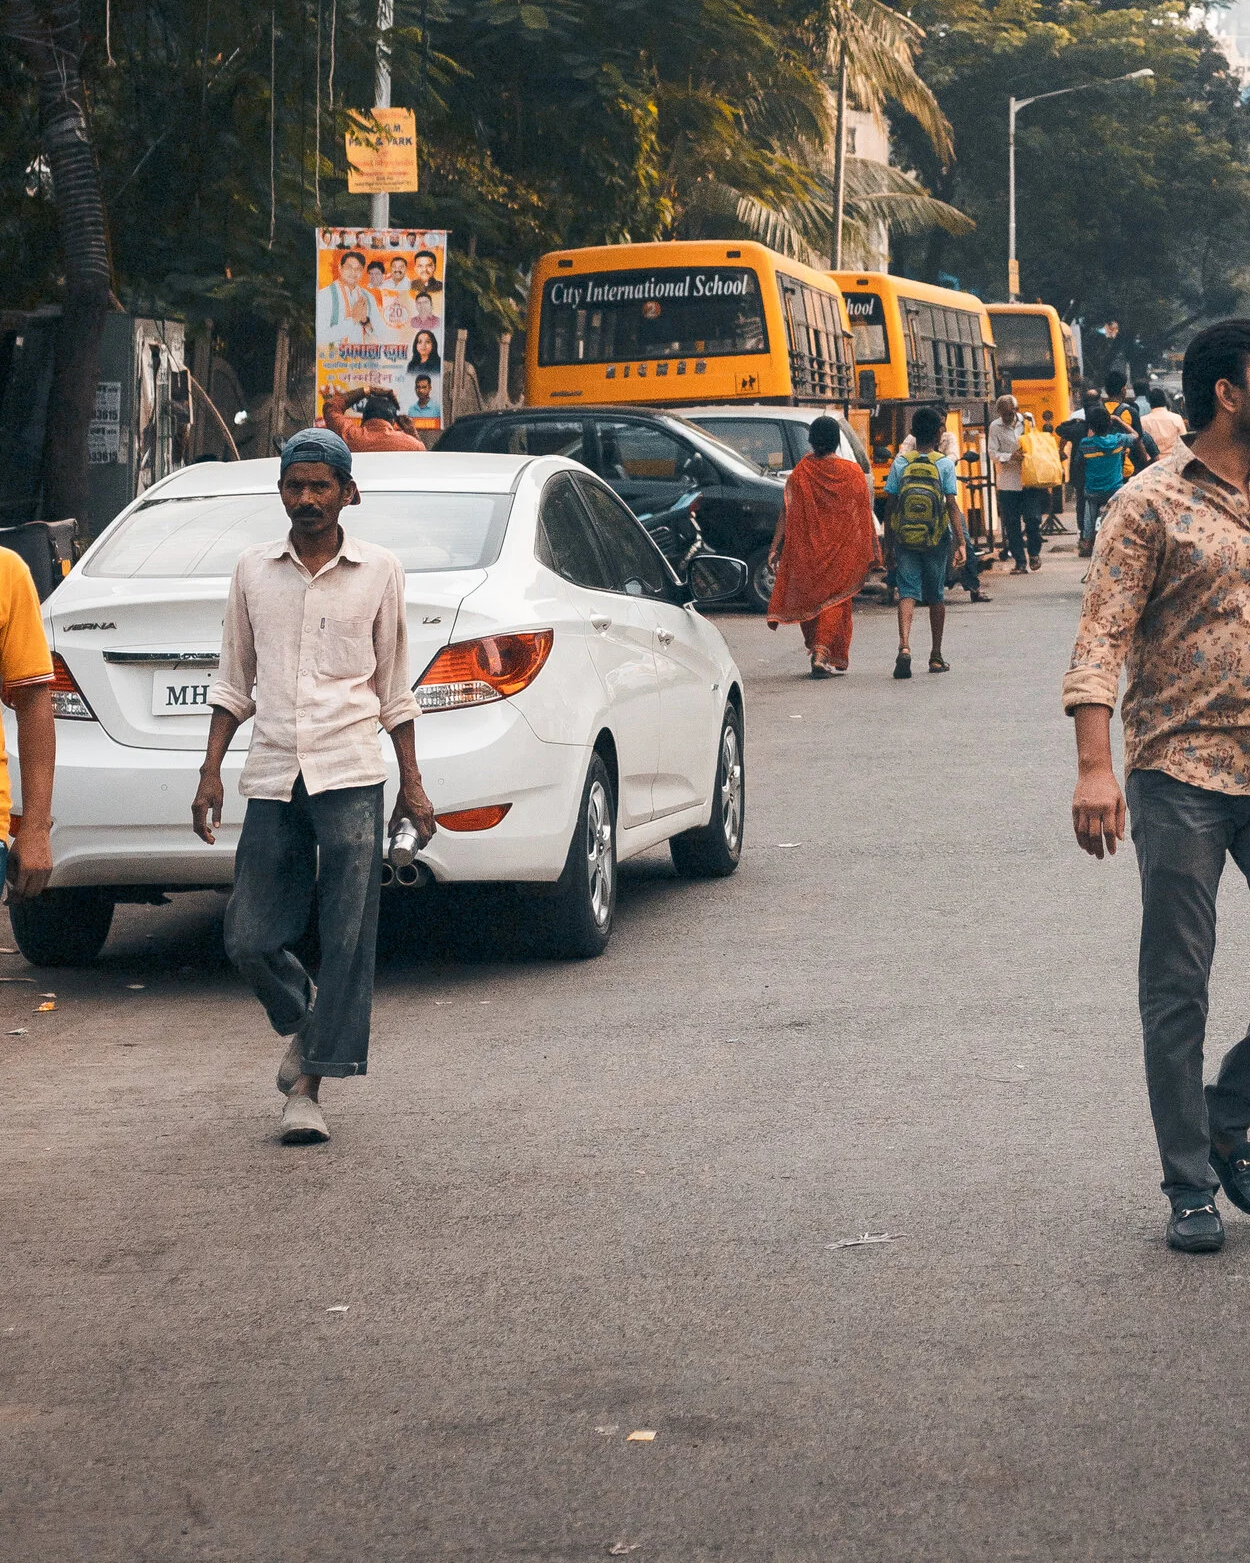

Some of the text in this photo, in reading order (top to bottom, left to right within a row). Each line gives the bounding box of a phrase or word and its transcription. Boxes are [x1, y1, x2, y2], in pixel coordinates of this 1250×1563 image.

[551, 274, 749, 308] City International School
[388, 306, 403, 319] 20
[63, 622, 118, 632] VERNA
[165, 684, 210, 706] MH
